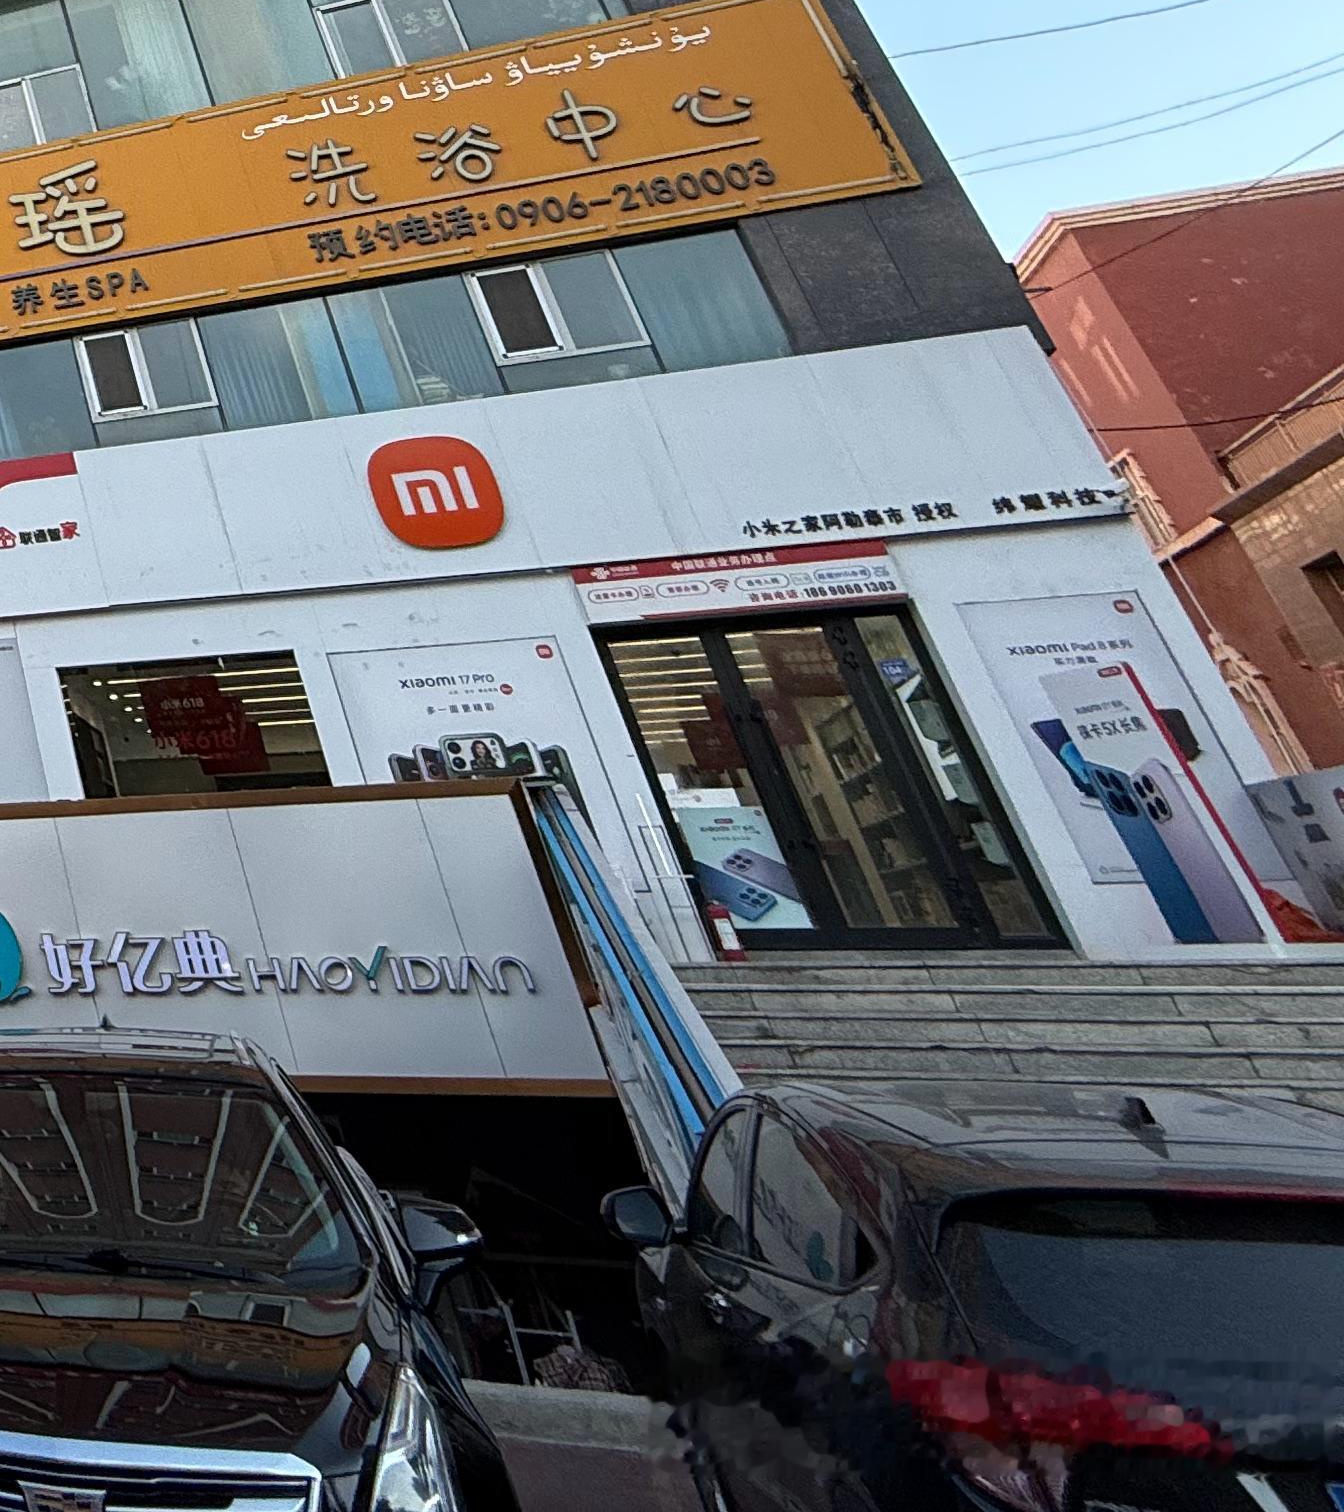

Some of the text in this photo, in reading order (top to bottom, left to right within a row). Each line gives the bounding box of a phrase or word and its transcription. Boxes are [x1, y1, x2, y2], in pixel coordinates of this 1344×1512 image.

[286, 86, 755, 208] 洗浴中心
[11, 268, 150, 315] 养生SPA
[911, 502, 960, 522] 授权
[18, 521, 80, 546] 联通智家
[458, 675, 470, 685] 17
[473, 674, 495, 683] Pro
[40, 929, 243, 995] 好亿典
